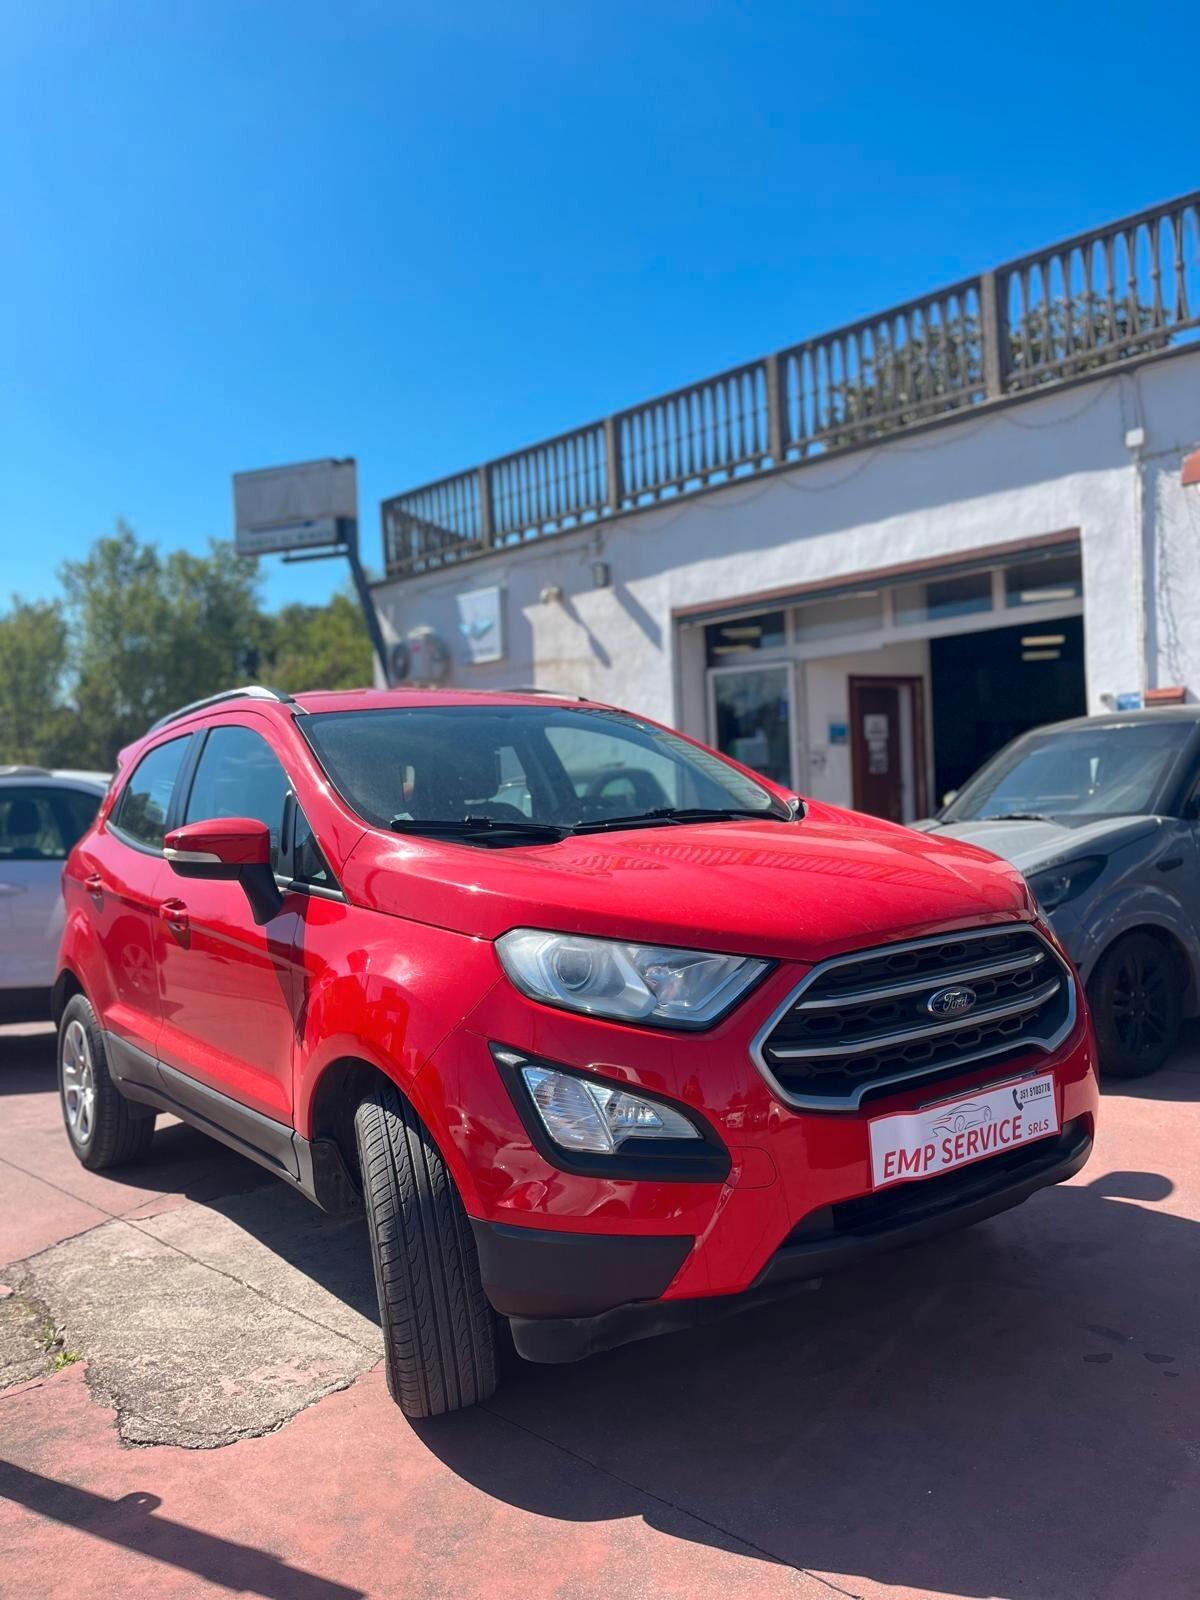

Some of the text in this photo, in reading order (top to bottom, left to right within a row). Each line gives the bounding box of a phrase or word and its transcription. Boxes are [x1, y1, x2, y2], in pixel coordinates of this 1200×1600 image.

[943, 991, 968, 1011] Ford
[883, 1115, 1049, 1179] EMP SERVICE SRLS
